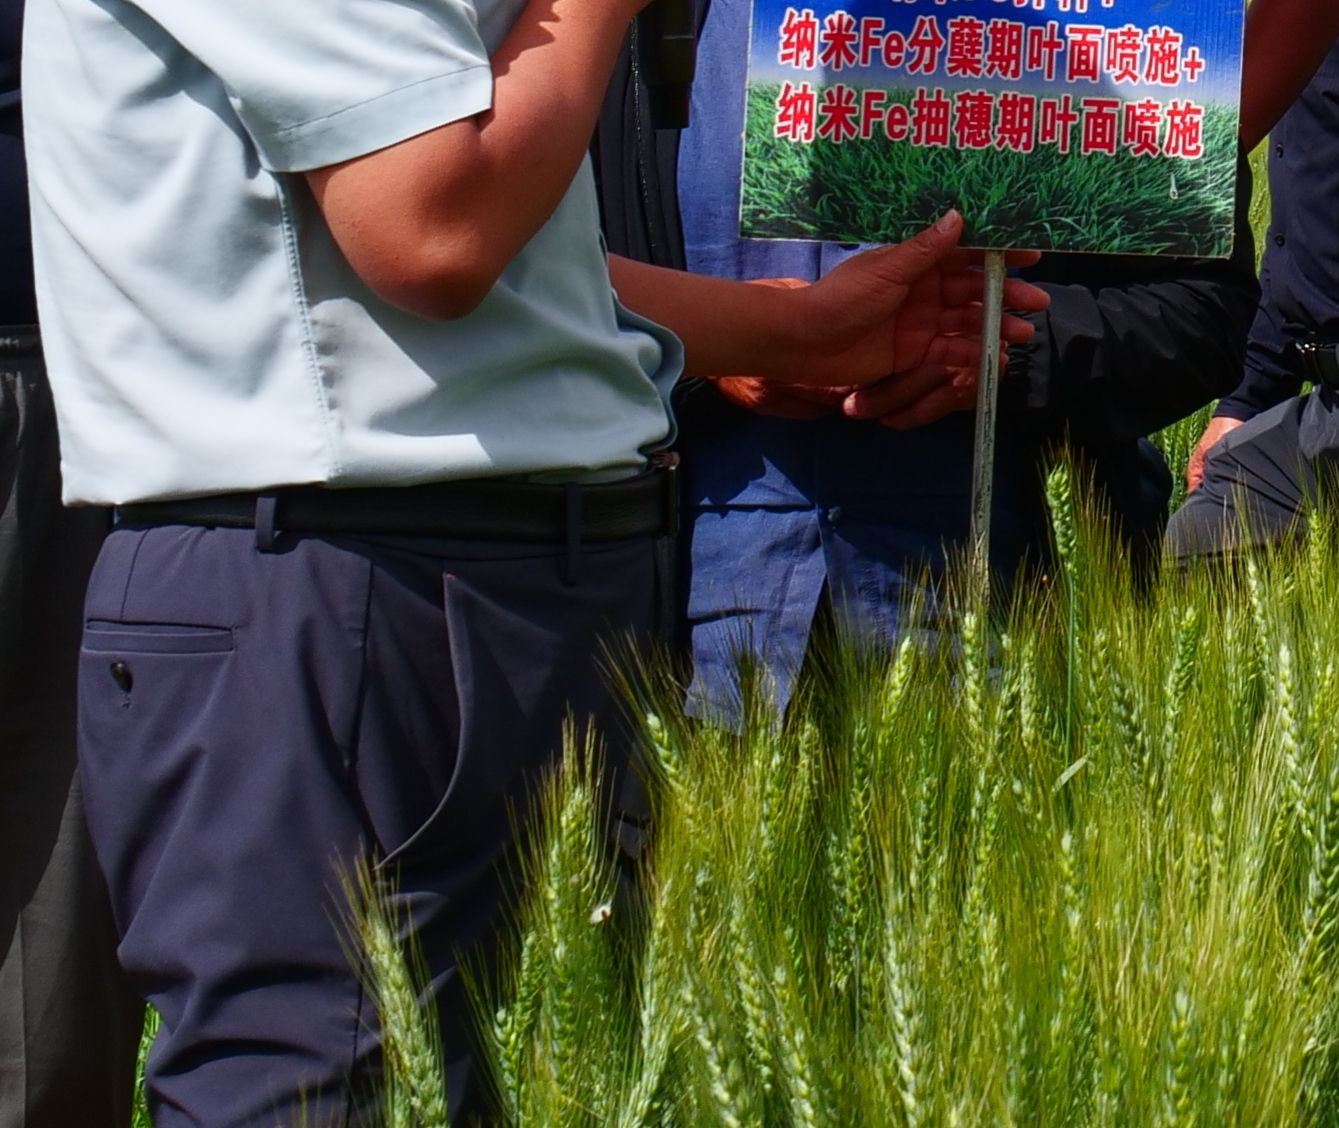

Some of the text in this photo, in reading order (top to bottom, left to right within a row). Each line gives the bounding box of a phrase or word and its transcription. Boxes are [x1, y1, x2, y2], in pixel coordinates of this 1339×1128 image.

[776, 83, 1203, 158] 纳米Fe抽穗期叶面喷施
